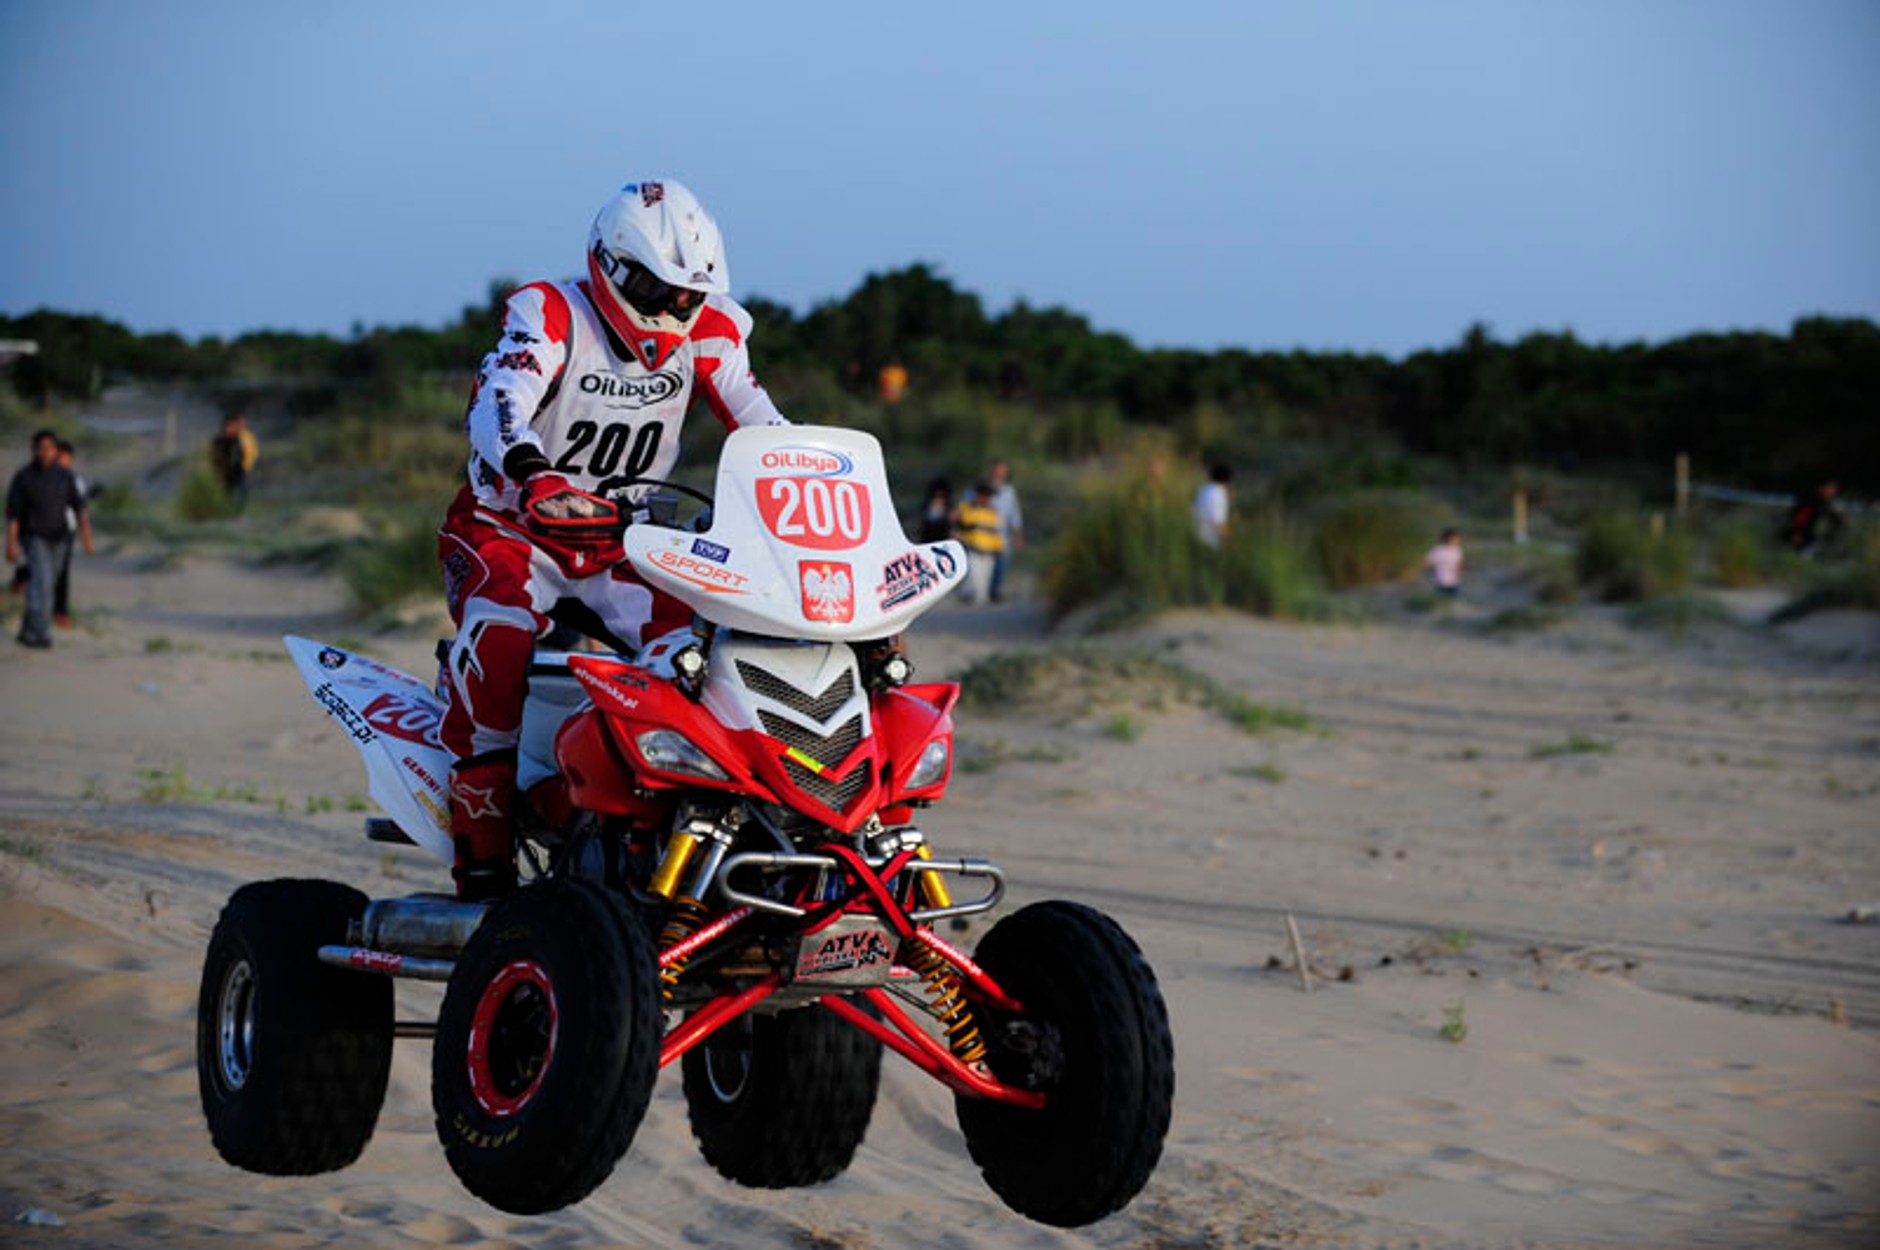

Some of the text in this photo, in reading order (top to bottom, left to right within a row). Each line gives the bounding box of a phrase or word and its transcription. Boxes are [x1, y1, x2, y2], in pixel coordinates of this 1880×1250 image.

[580, 373, 668, 402] OiLibya
[554, 420, 664, 479] 200
[761, 451, 839, 472] OiLibya
[771, 479, 862, 540] 200
[661, 551, 750, 587] SPORT
[884, 553, 912, 585] ATV
[819, 930, 868, 956] ATV
